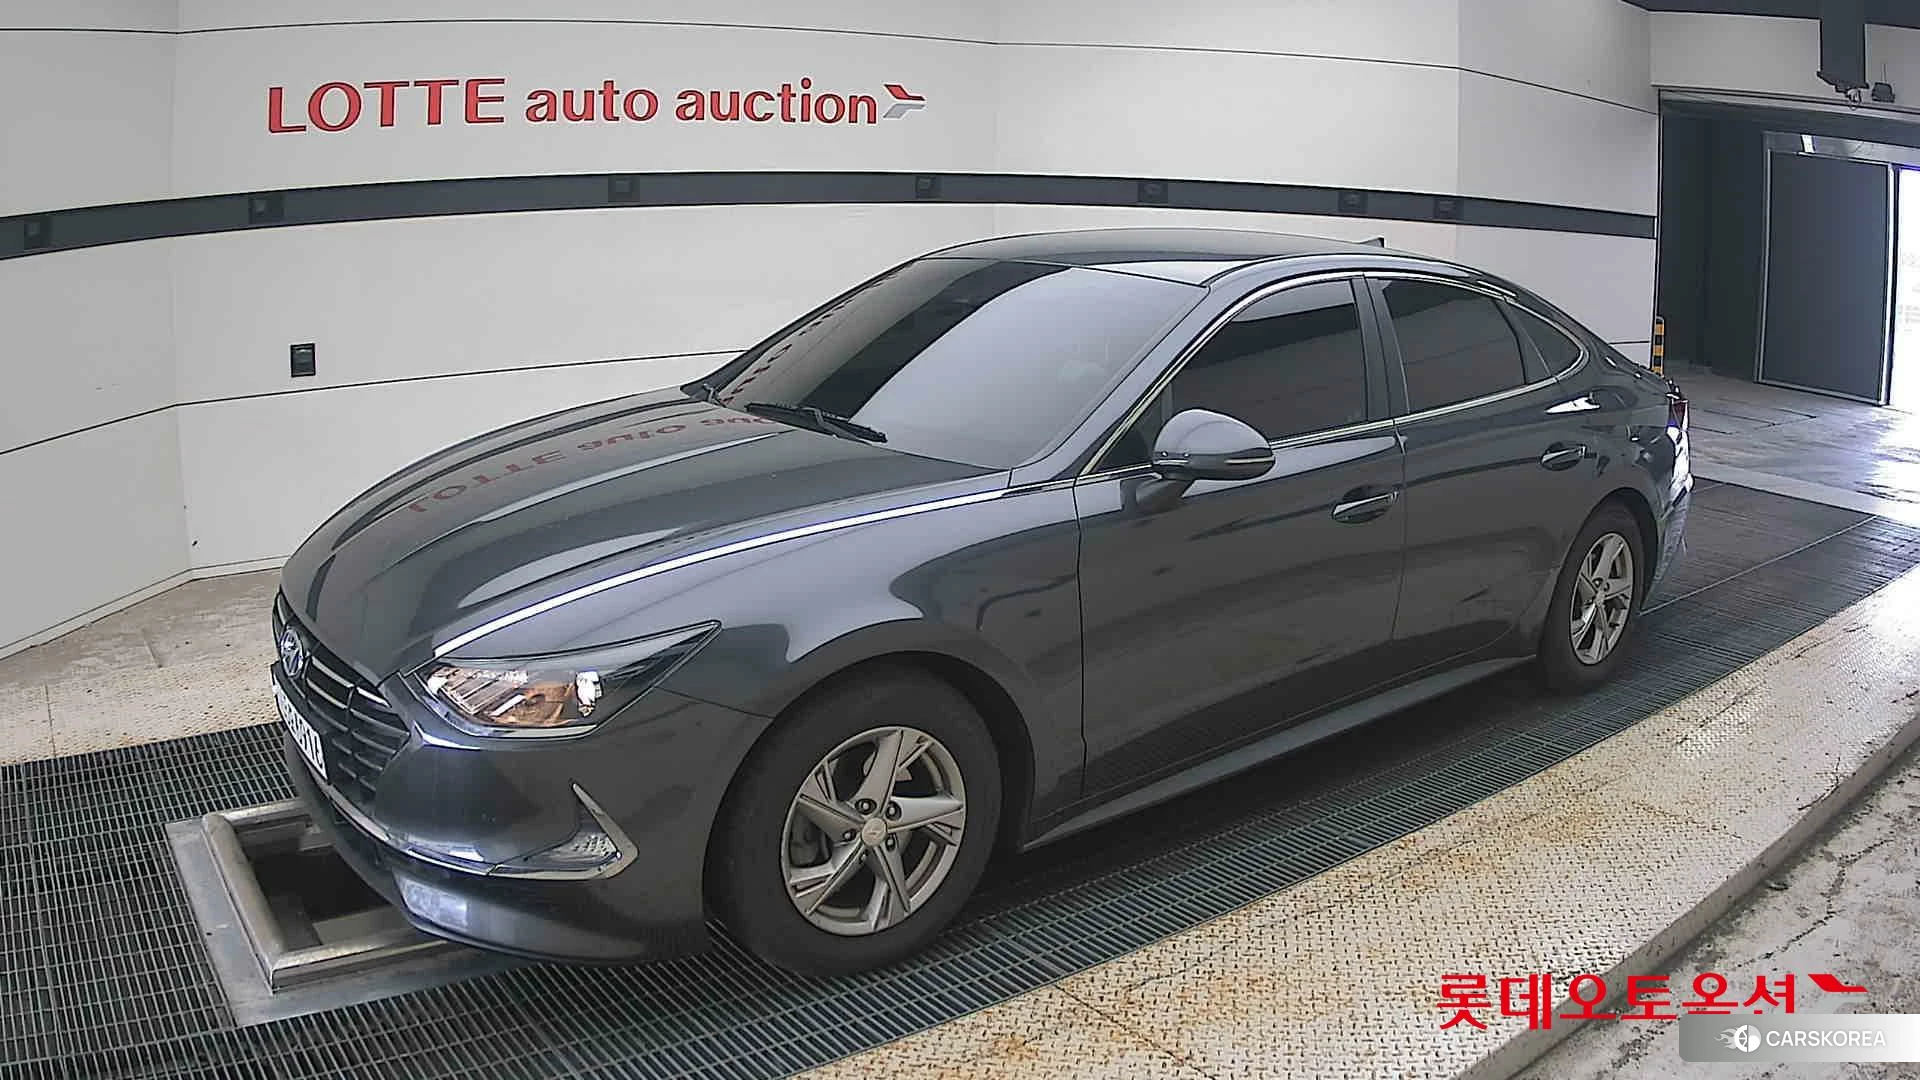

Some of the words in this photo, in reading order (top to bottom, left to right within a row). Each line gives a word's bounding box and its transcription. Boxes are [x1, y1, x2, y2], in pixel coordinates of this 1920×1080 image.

[267, 78, 505, 134] LOTTE
[525, 79, 659, 123] auto
[674, 78, 878, 125] auction
